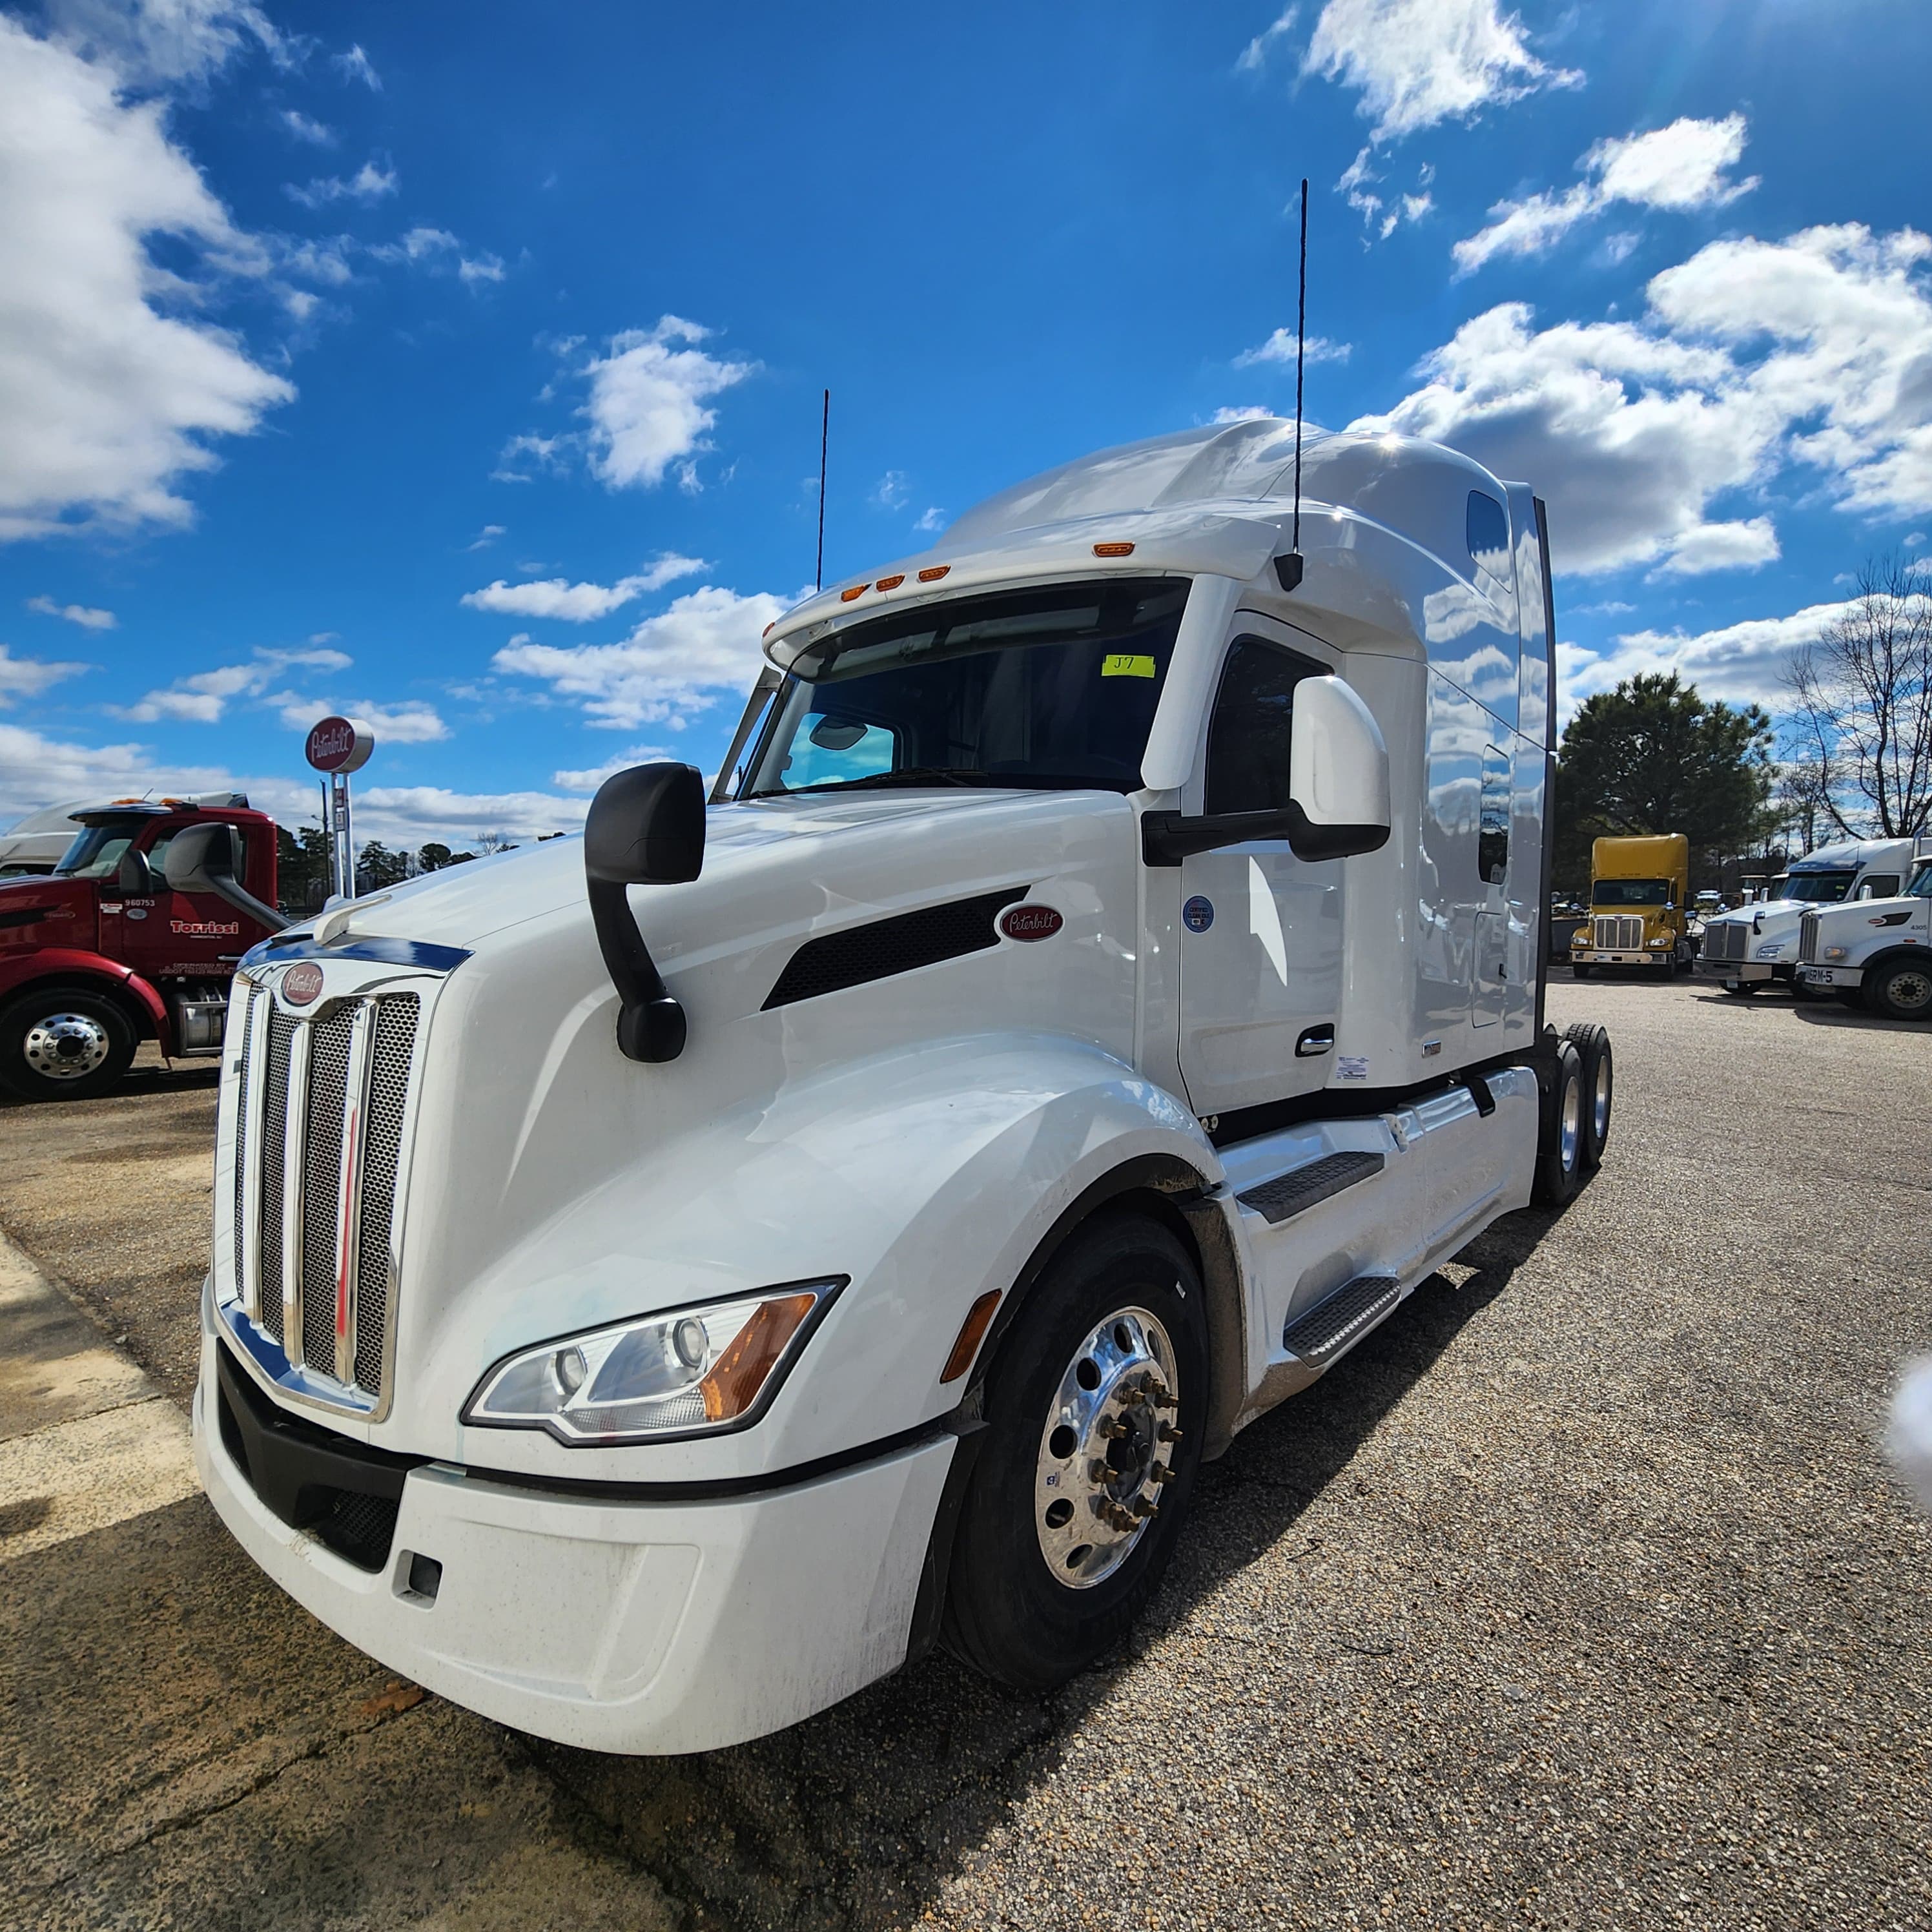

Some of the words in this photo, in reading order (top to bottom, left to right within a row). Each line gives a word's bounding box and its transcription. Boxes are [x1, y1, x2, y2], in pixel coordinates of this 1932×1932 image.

[1114, 657, 1135, 670] J7
[311, 726, 352, 763] Peterbilt
[170, 920, 238, 934] Torrissi
[1009, 912, 1058, 933] Peterbilt
[285, 970, 322, 993] Peterbilt
